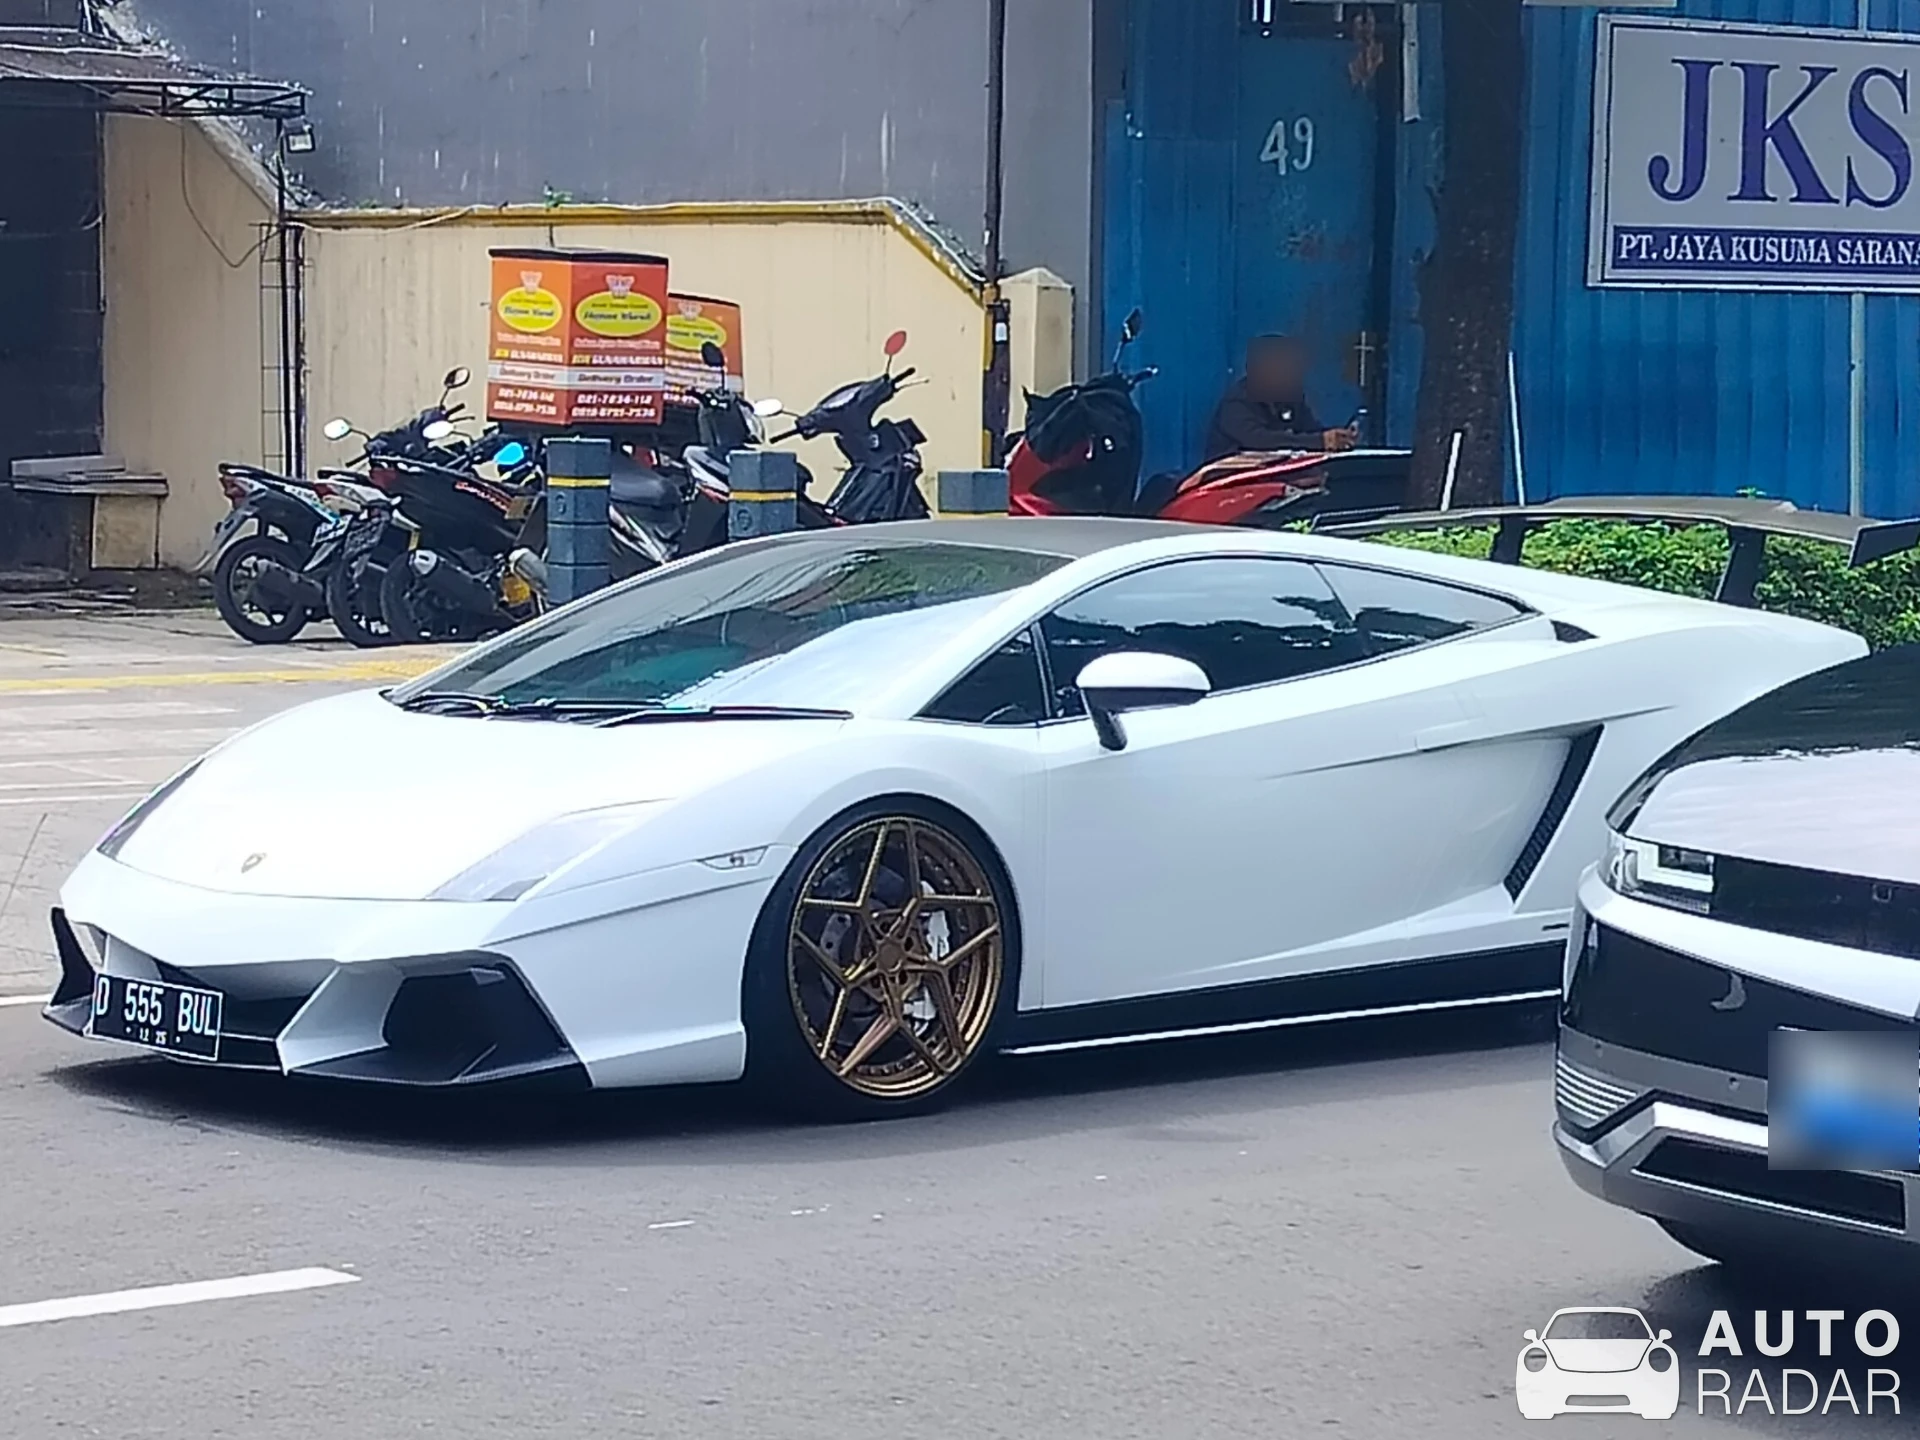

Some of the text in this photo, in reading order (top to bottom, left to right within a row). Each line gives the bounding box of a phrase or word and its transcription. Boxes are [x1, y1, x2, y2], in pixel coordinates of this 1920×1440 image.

[1260, 116, 1313, 176] 49
[1648, 57, 1912, 209] JKS
[1619, 233, 1657, 260] PT.
[1663, 234, 1725, 261] JAYA
[1730, 236, 1832, 264] KUSUMA
[96, 977, 216, 1036] D 555 BUL
